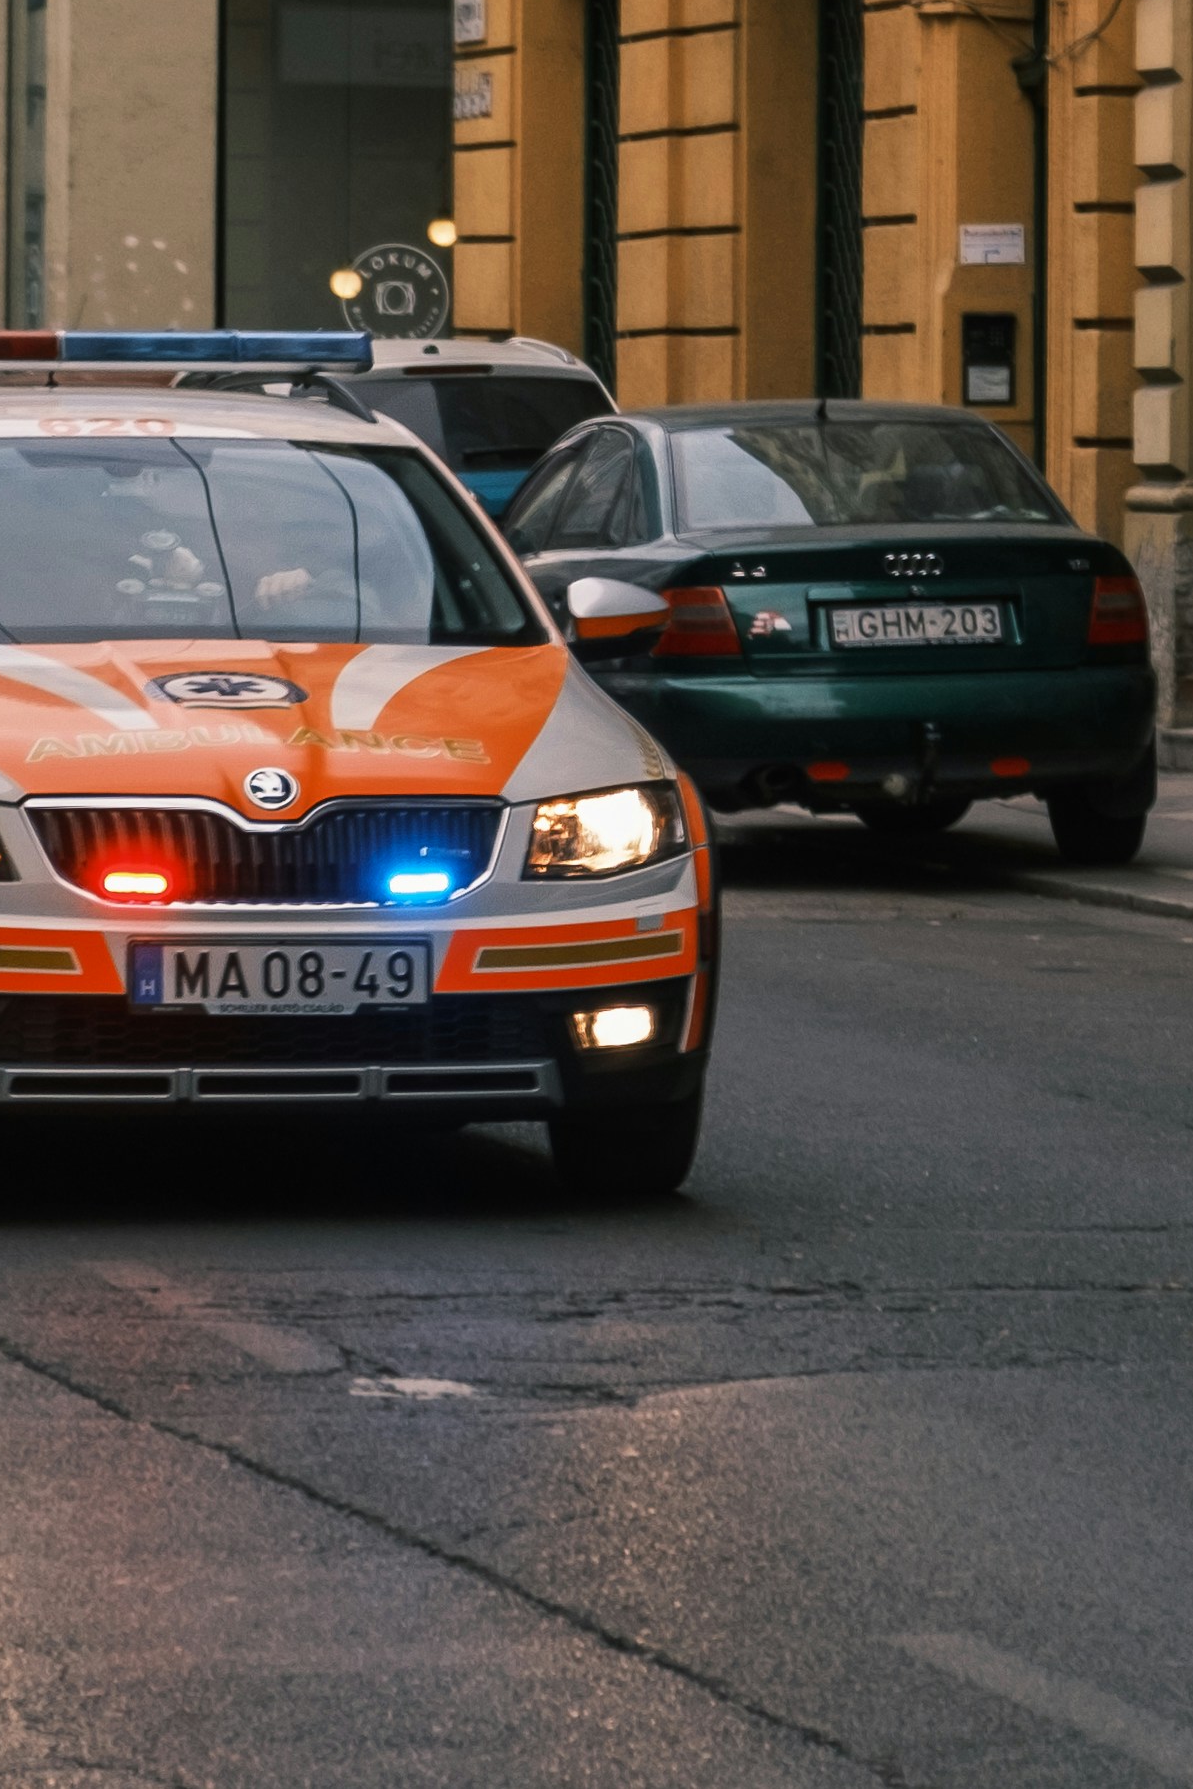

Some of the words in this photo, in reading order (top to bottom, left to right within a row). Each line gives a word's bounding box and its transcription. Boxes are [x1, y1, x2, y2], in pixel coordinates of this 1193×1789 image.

[359, 252, 433, 280] LOKUM
[38, 417, 177, 437] 620
[857, 607, 999, 638] GHM-203
[25, 725, 492, 765] AMBULANCE
[139, 979, 156, 996] H
